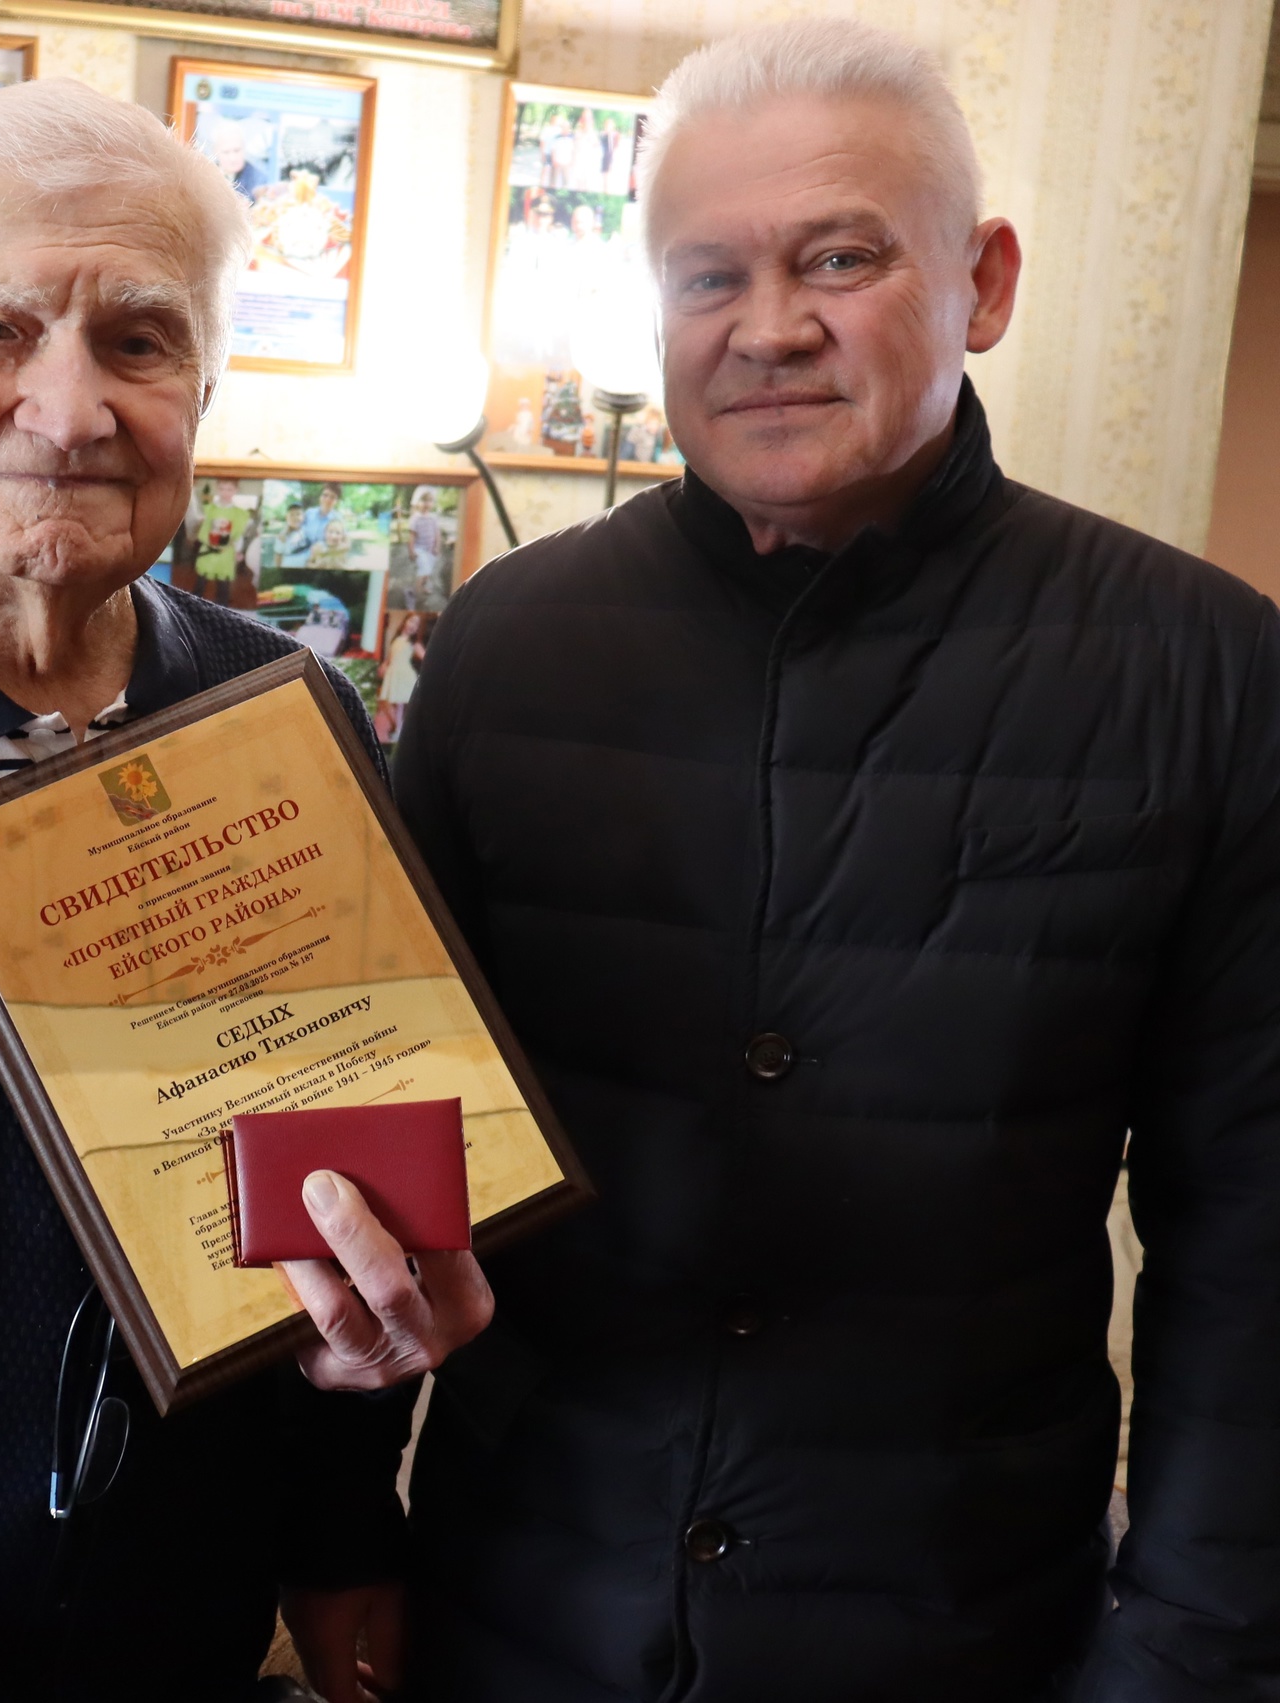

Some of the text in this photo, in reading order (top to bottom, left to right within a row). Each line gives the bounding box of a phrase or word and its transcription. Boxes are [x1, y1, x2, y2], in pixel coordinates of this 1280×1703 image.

[38, 798, 301, 928] СВИДЕТЕЛЬСТВО
[86, 795, 218, 858] Муниципальное образование
[126, 821, 192, 854] Ейский район
[62, 841, 325, 970] «ПОЧЕТНЫЙ ГРАЖДАНИН
[106, 886, 302, 981] ЕЙСКОГО РАЙОНА»
[143, 878, 200, 908] присвоении
[199, 864, 232, 884] звания
[129, 933, 332, 1031] Решением Совета муниципального образования
[155, 1009, 191, 1031] Ейский
[189, 998, 218, 1017] район
[217, 993, 228, 1002] от
[227, 972, 271, 999] 27.03.2025
[268, 964, 291, 979] года
[299, 951, 315, 965] 187
[215, 1001, 296, 1049] СЕДЫХ
[218, 988, 265, 1014] присвоено
[156, 994, 372, 1106] Афанасию Тихоновичу
[161, 1106, 224, 1141] Участнику
[223, 1080, 276, 1112] Великой
[274, 1040, 361, 1087] Отечественной
[360, 1024, 399, 1048] войны
[196, 1125, 221, 1143] «За
[292, 1073, 328, 1095] вклад
[327, 1070, 335, 1078] в
[334, 1048, 377, 1075] Победу
[153, 1168, 161, 1176] в
[160, 1137, 213, 1173] Великой
[299, 1085, 335, 1107] войне
[334, 1070, 361, 1090] 1941
[368, 1053, 395, 1073] 1945
[395, 1038, 432, 1062] годов»
[188, 1207, 220, 1227] Глава
